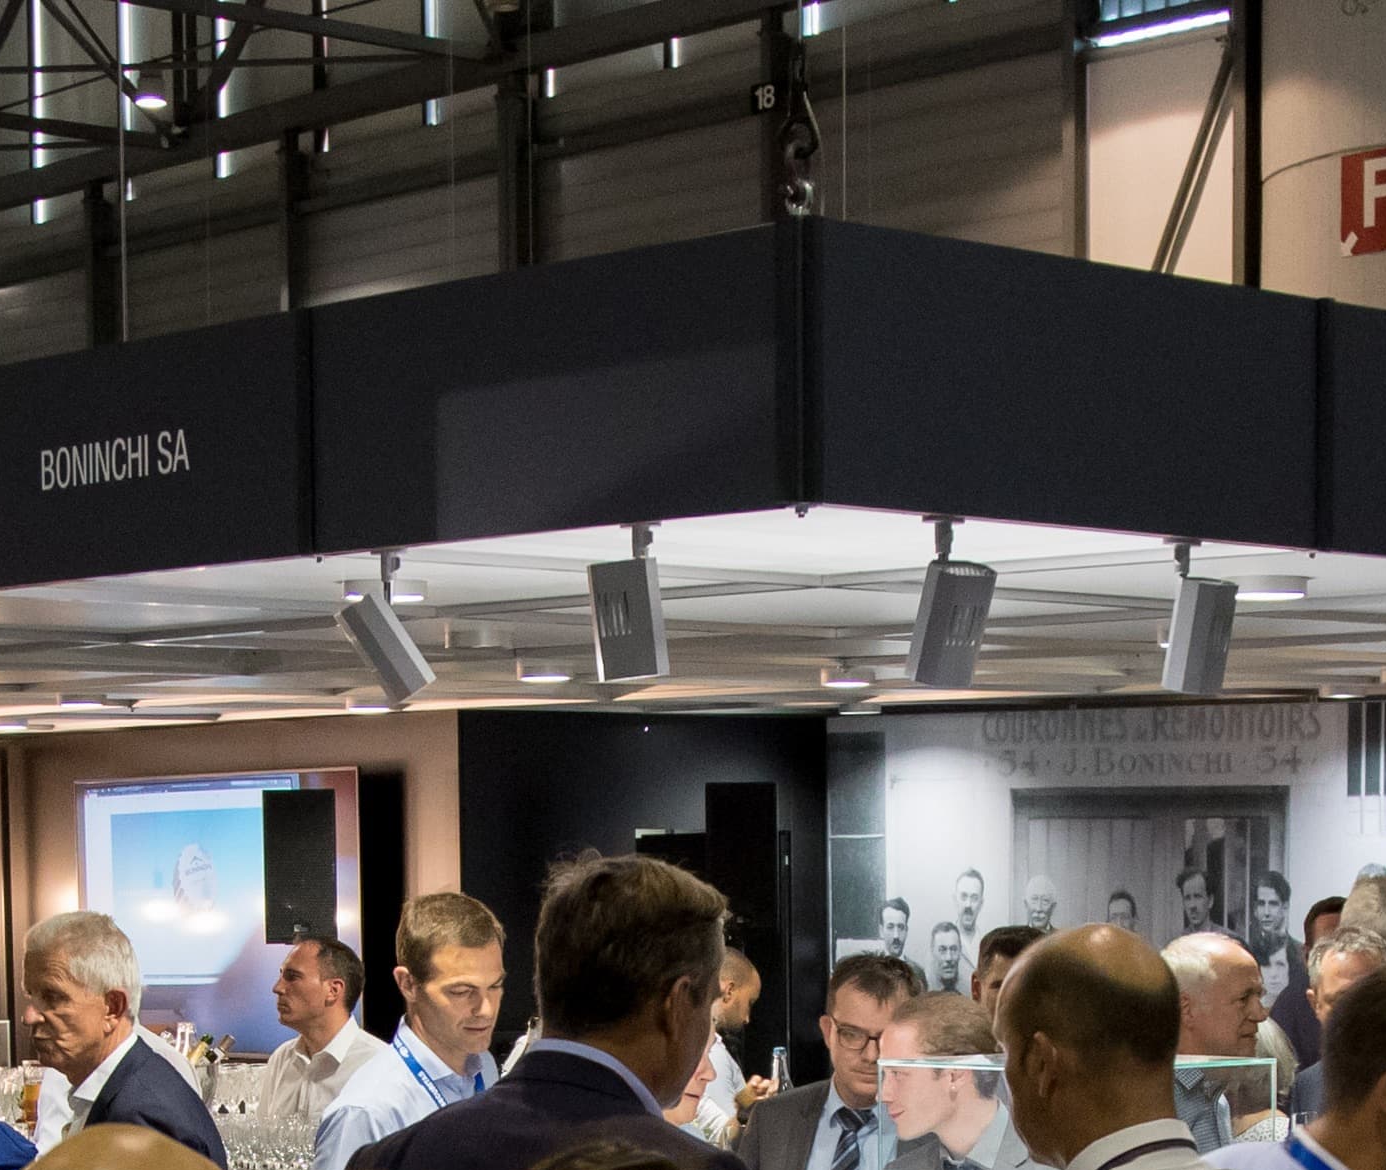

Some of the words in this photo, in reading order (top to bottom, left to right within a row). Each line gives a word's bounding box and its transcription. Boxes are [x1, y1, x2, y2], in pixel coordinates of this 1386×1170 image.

[755, 85, 775, 110] 18
[41, 434, 149, 491] BONINCHI
[157, 429, 190, 475] SA
